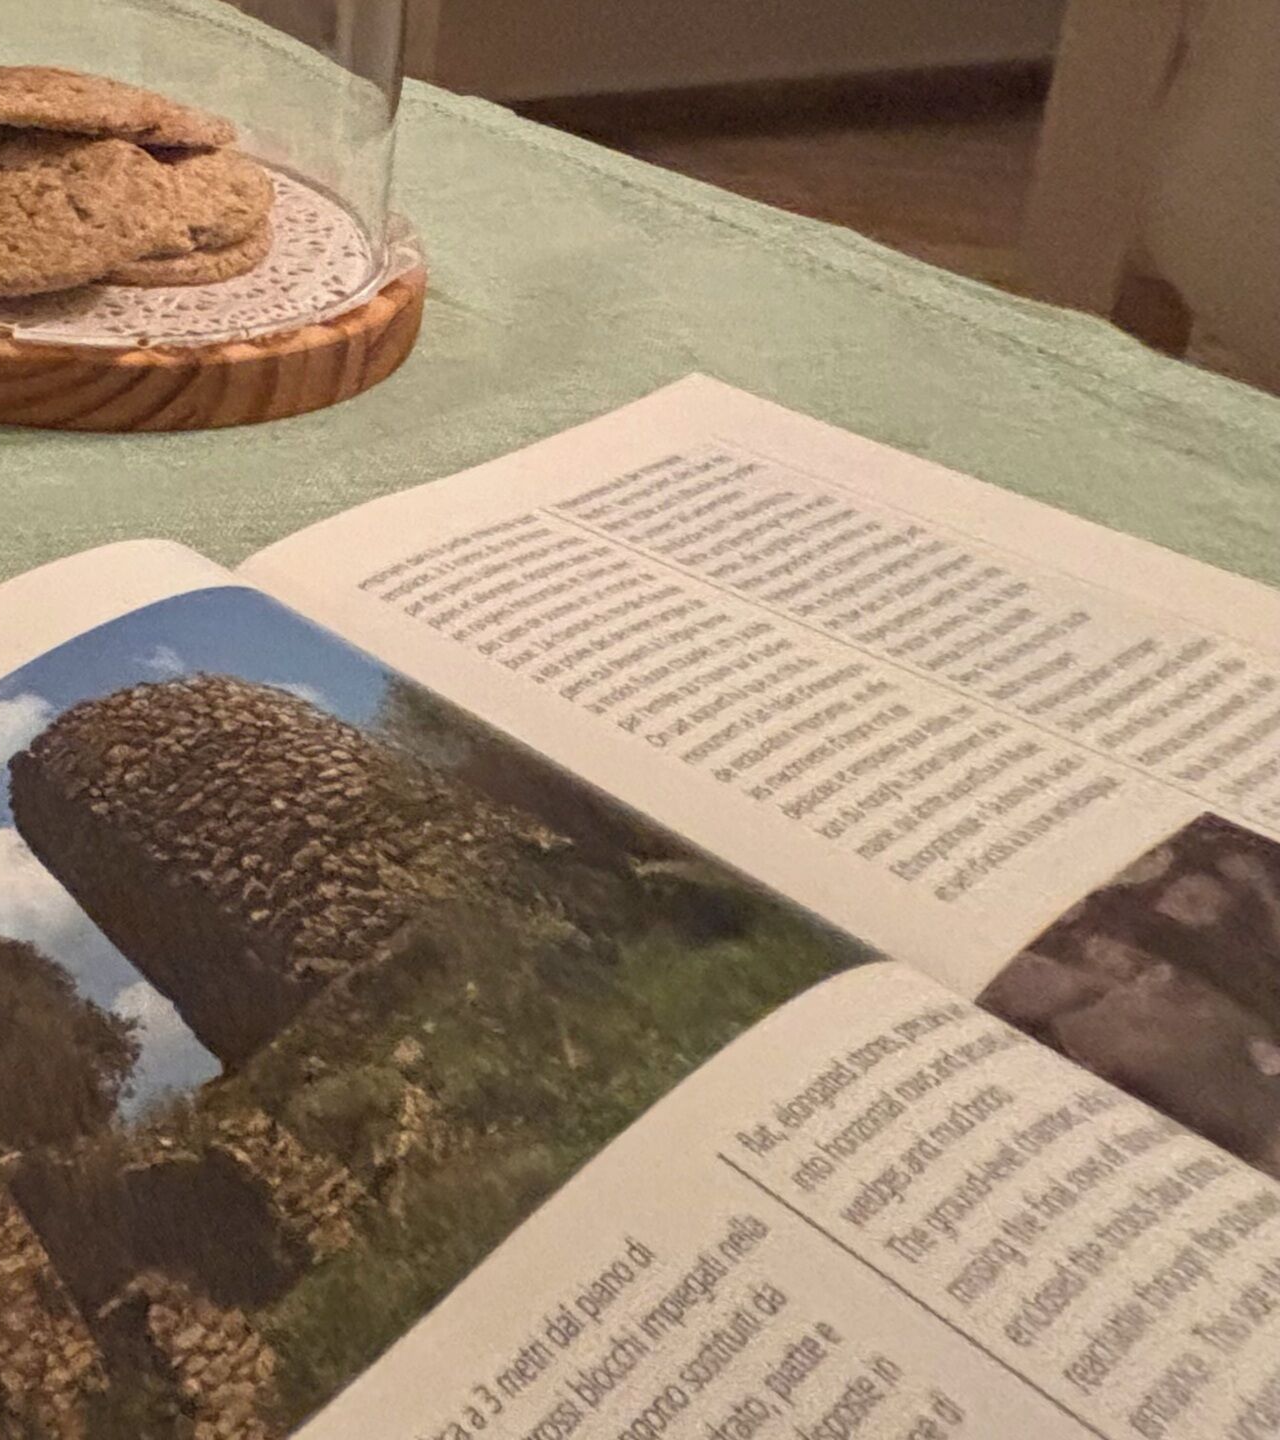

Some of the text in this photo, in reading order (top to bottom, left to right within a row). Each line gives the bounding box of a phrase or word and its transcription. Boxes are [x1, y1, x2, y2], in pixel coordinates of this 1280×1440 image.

[473, 1384, 503, 1415] 3
[496, 1336, 556, 1399] metri
[576, 1260, 635, 1324] piano
[626, 1236, 656, 1270] di
[566, 1325, 650, 1412] blocchi
[640, 1250, 729, 1342] impiegati
